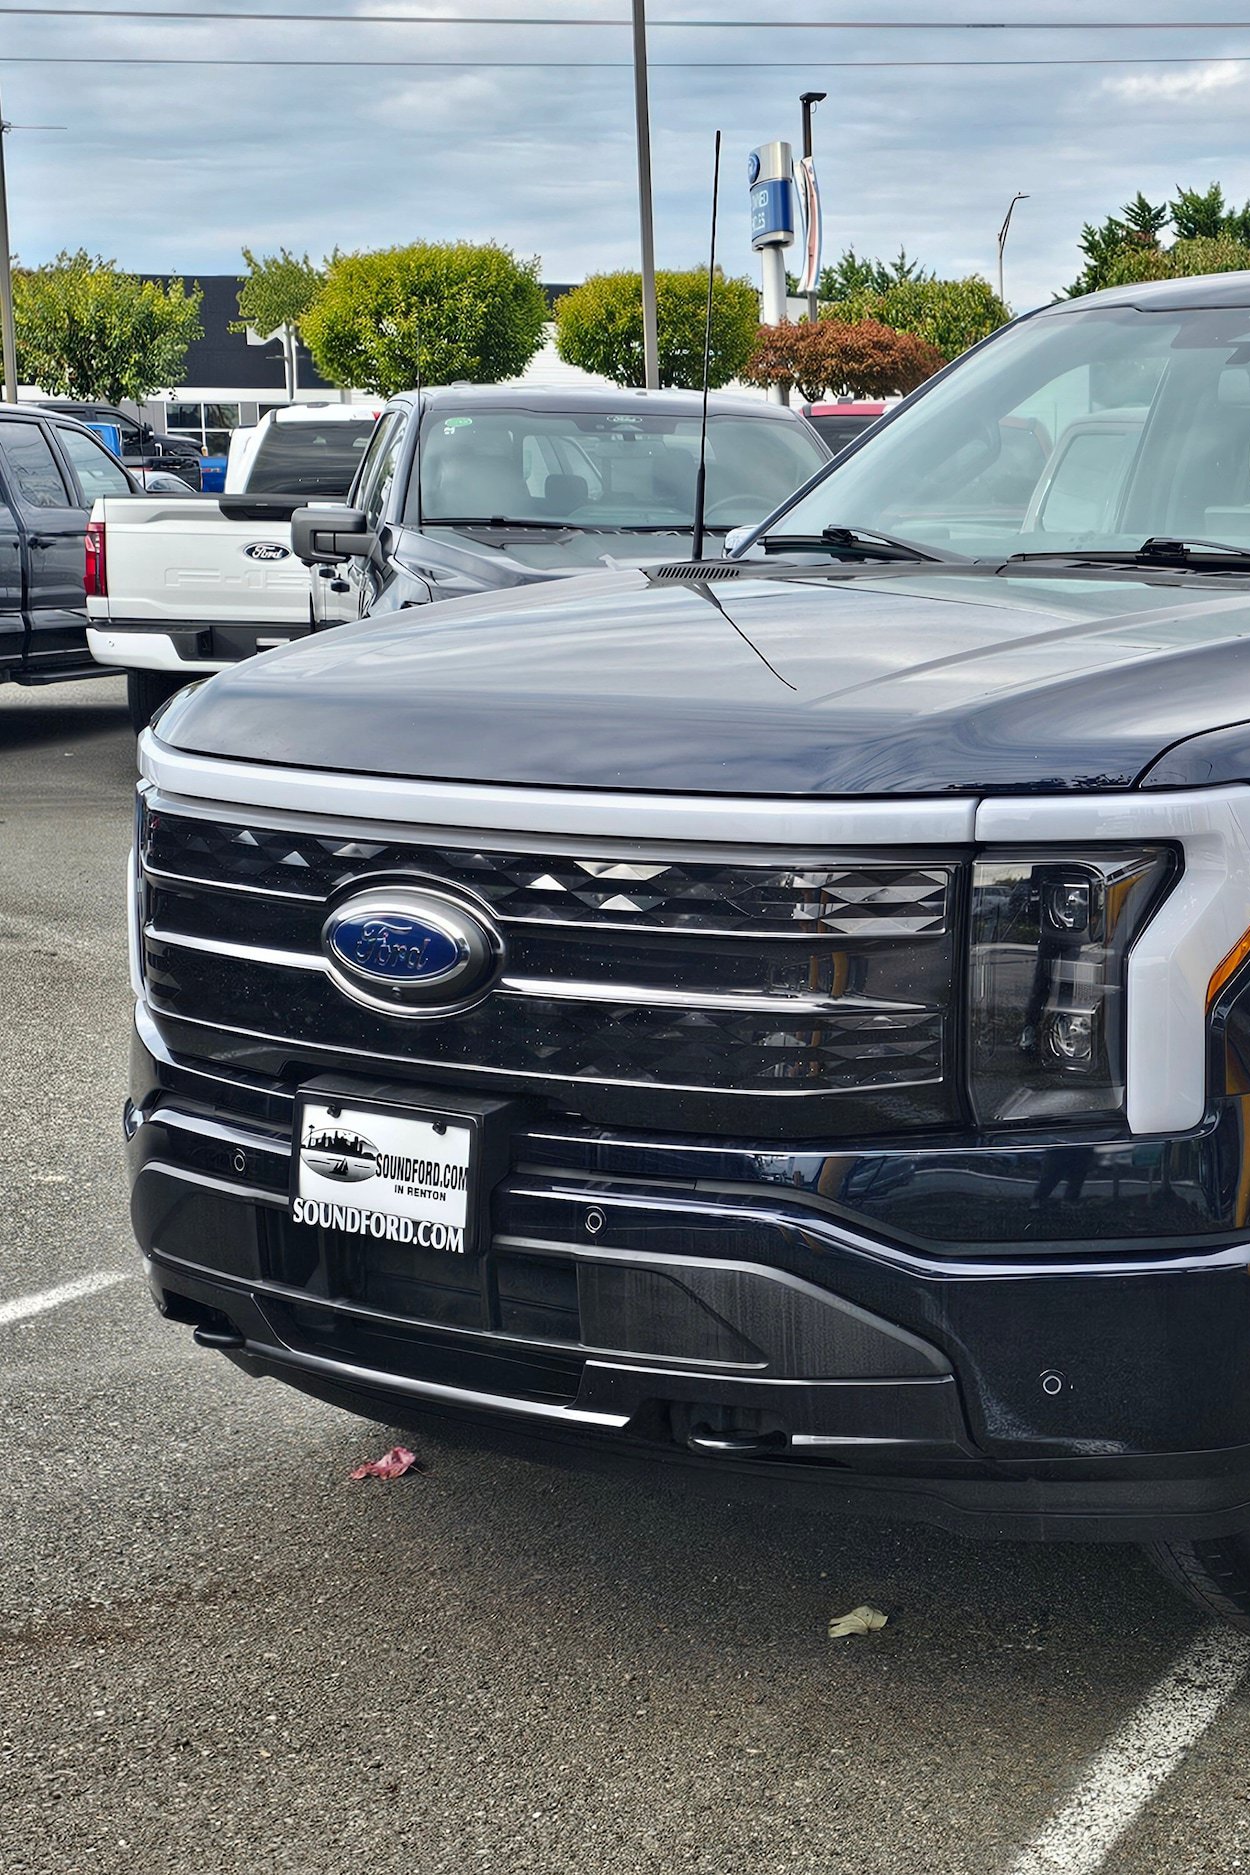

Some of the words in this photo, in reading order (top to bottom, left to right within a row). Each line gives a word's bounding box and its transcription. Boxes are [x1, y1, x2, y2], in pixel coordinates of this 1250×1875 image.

[252, 545, 284, 559] Ford
[164, 567, 313, 591] F-15
[355, 920, 433, 971] Ford
[375, 1152, 468, 1192] SOUNDFORD.COM
[394, 1184, 404, 1195] IN
[407, 1187, 447, 1202] RENTON
[292, 1197, 465, 1254] SOUNDFORD.COM
